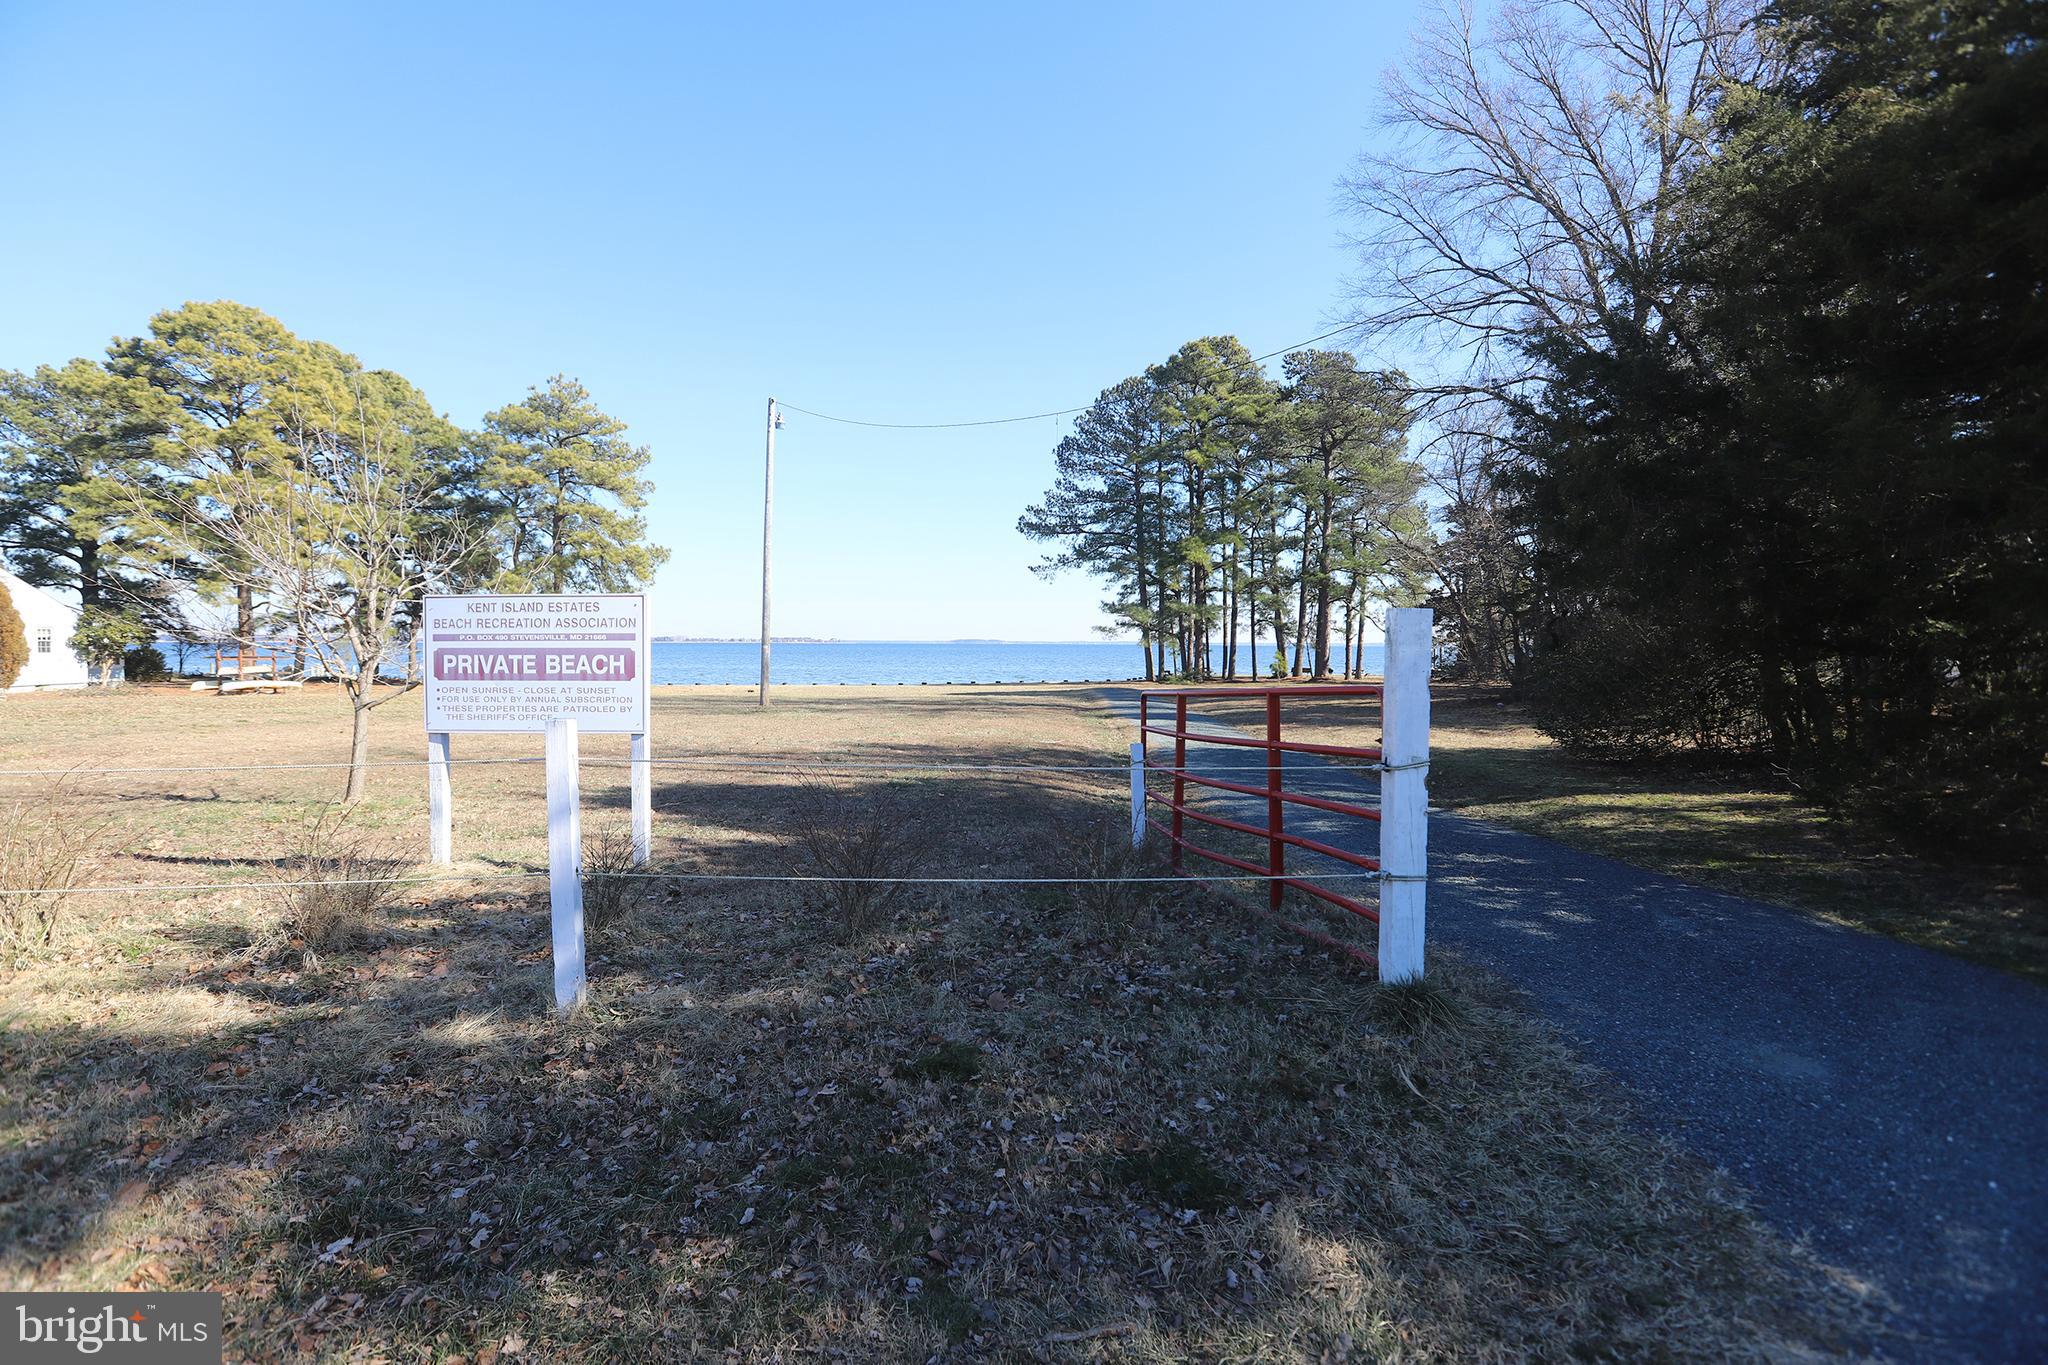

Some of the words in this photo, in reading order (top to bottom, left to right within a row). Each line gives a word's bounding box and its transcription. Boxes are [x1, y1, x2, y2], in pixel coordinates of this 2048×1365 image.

[467, 602, 497, 613] KENT
[501, 602, 544, 612] ISLAND
[548, 601, 600, 612] ESTATES
[433, 618, 472, 629] BEACH
[476, 617, 551, 628] RECREATION
[555, 617, 637, 628] ASSOCIATION
[443, 654, 536, 675] PRIVATE
[545, 654, 625, 675] BEACH
[441, 686, 468, 694] OPEN
[471, 686, 514, 694] SUNRISE
[523, 686, 557, 694] CLOSE
[576, 686, 617, 694] SUNSET
[441, 695, 459, 703] FOR
[462, 695, 480, 703] USE
[483, 695, 507, 703] ONLY
[510, 695, 522, 703] BY
[539, 705, 559, 713] ARE
[562, 705, 616, 713] PATROLED
[620, 705, 633, 713] BY
[446, 713, 465, 721] THE
[466, 713, 516, 721] SHERIFF'S
